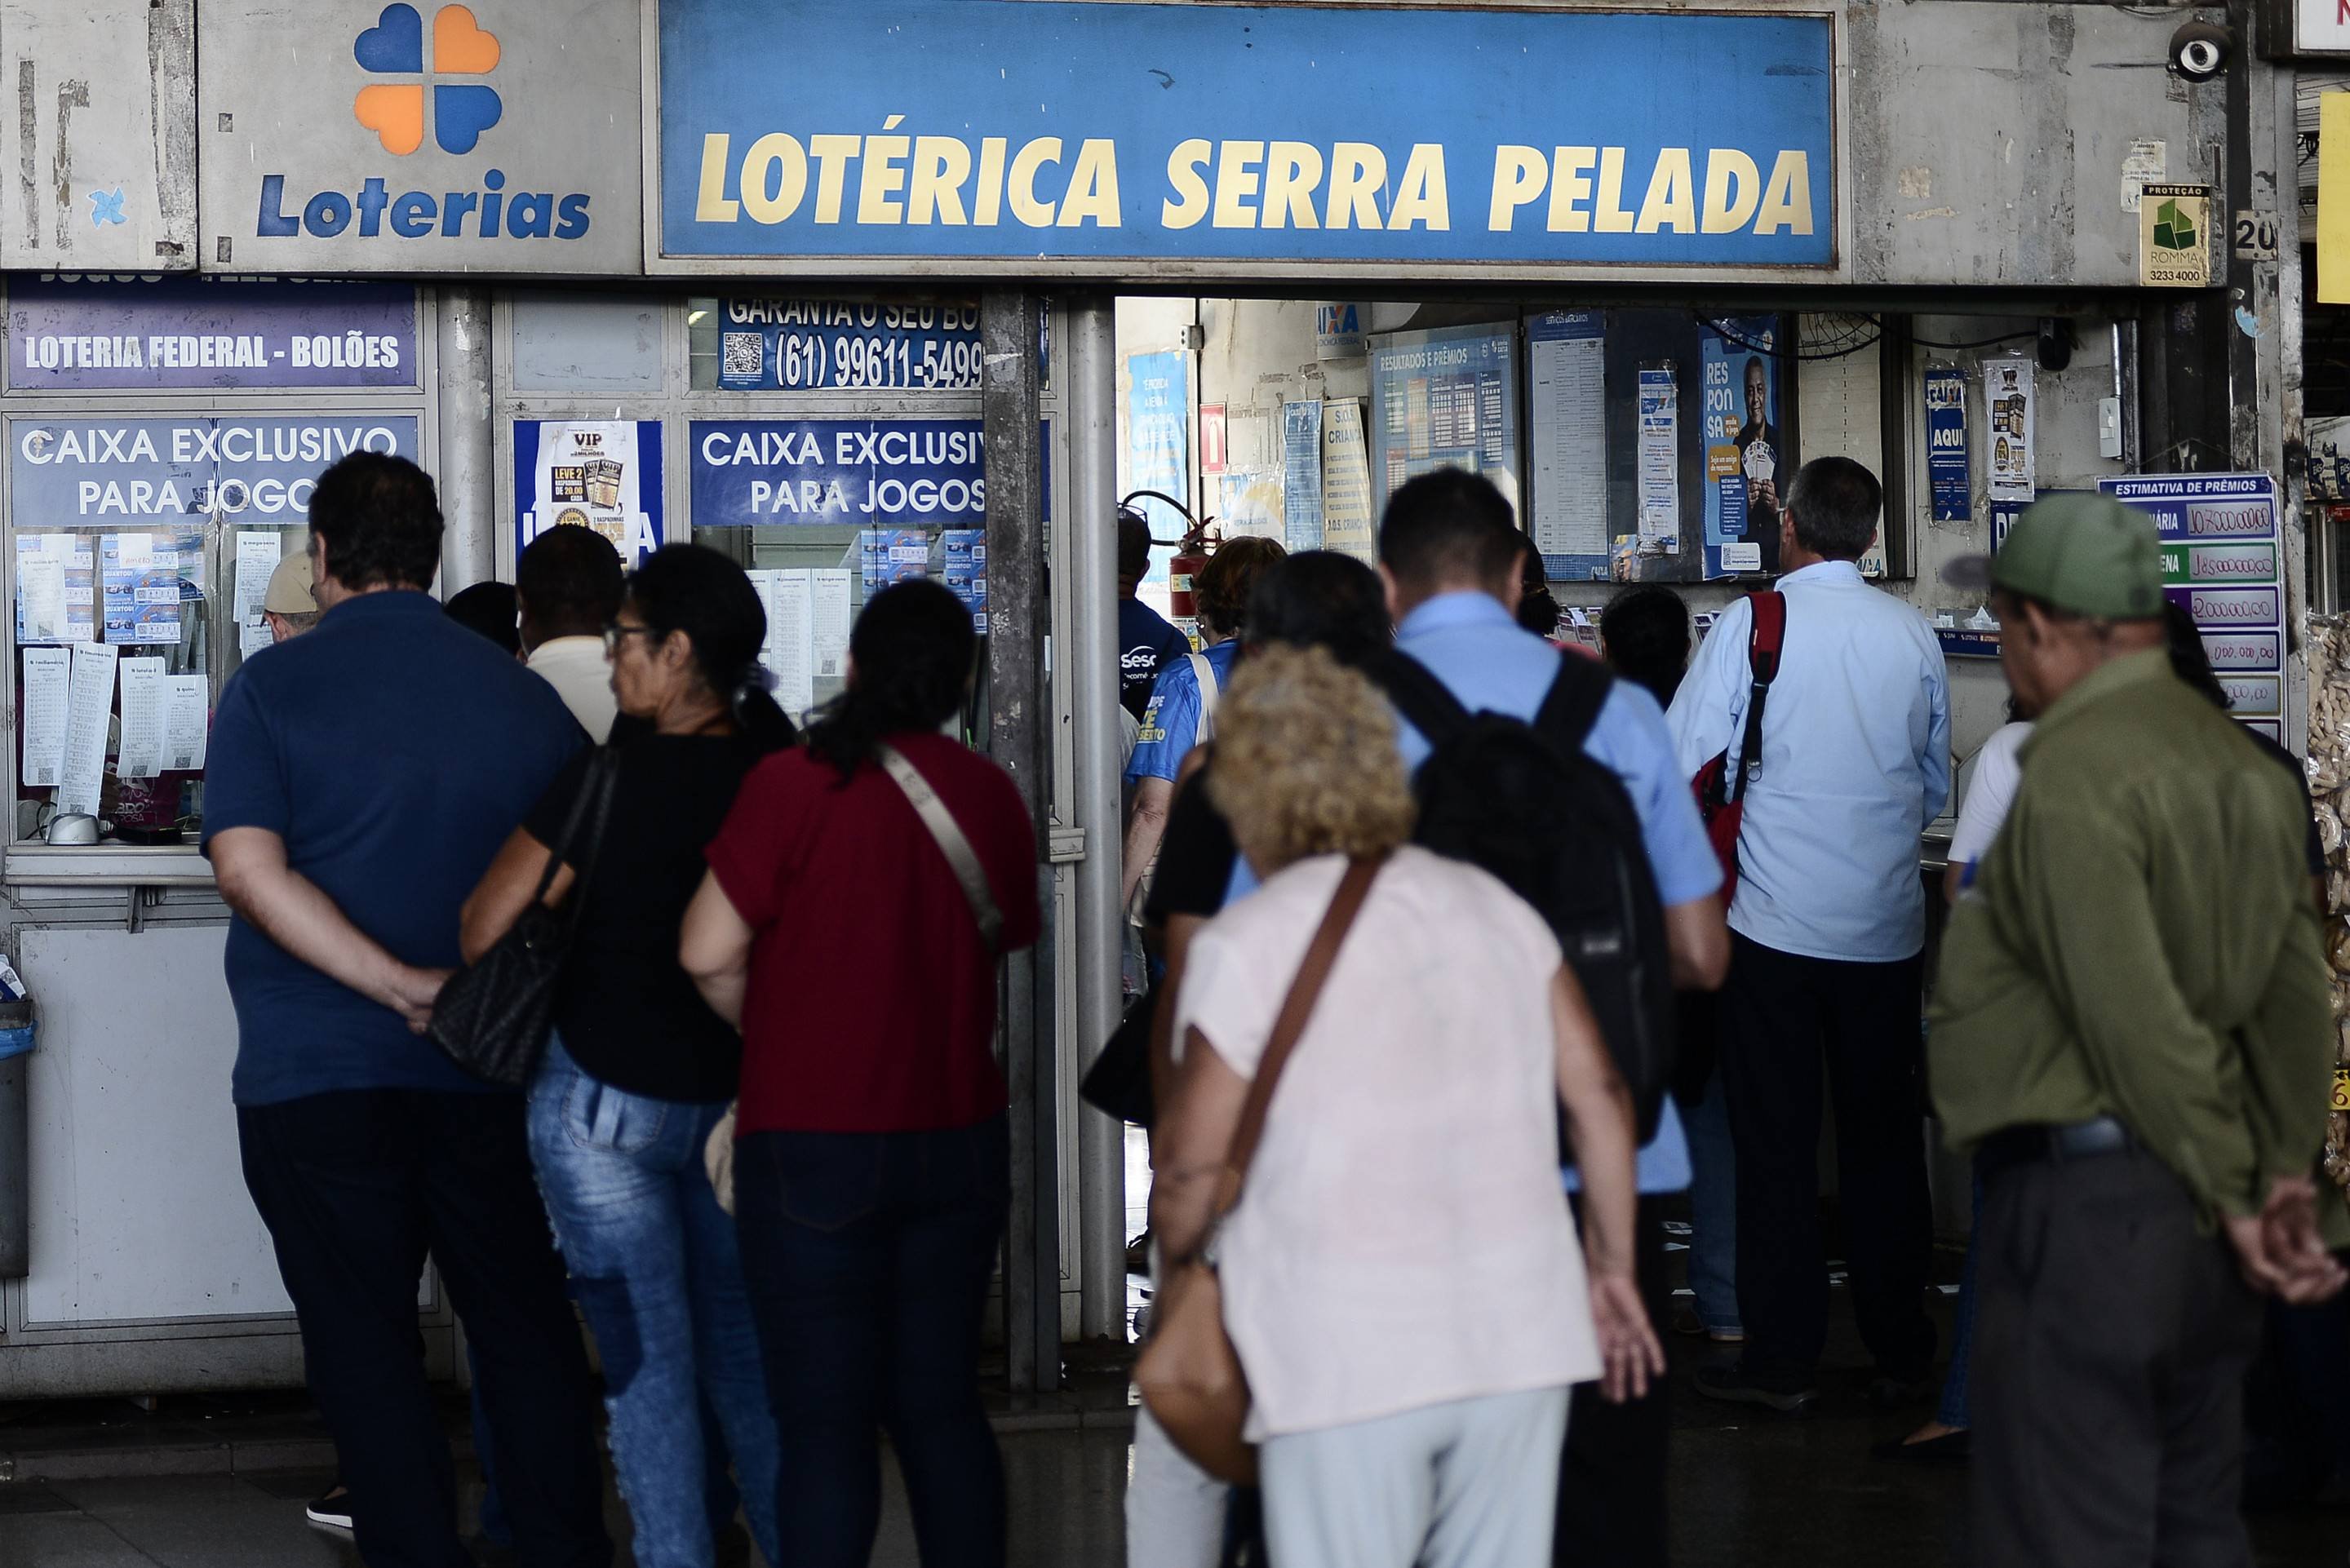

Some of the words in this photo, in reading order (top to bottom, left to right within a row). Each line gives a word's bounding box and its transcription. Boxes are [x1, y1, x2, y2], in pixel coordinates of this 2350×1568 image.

[695, 114, 1122, 228] LOTÉRICA
[1161, 138, 1450, 231] SERRA
[1488, 144, 1814, 236] PELADA
[2148, 186, 2202, 196] PROTEÇÃO
[256, 169, 591, 240] Loterias
[2237, 219, 2275, 250] 20
[2151, 251, 2199, 264] ROMMA
[2150, 271, 2174, 281] 3233
[2175, 271, 2200, 281] 4000
[25, 336, 143, 368] LOTERIA
[150, 336, 268, 368] FEDERAL
[292, 330, 399, 368] BOLÕES
[1381, 352, 1426, 372] RESULTADOS
[1428, 351, 1432, 366] E
[1434, 346, 1467, 366] PRÊMIOS
[776, 334, 827, 387] (61)
[834, 335, 982, 389] 99611-5499
[1707, 361, 1728, 385] RES
[1707, 388, 1733, 411] PON
[1707, 415, 1723, 438] SA
[1933, 428, 1963, 447] AQUI
[21, 429, 158, 464] CAIXA
[172, 427, 397, 463] EXCLUSIVO
[574, 433, 602, 446] VIP
[703, 432, 824, 466] CAIXA
[836, 431, 984, 465] EXCLUSI
[555, 468, 574, 480] LEVE
[576, 468, 583, 480] 2
[80, 481, 184, 514] PARA
[197, 479, 315, 515] JOGO
[556, 486, 564, 495] DE
[752, 480, 849, 513] PARA
[859, 479, 986, 513] JOGOS
[2116, 482, 2184, 495] ESTIMATIVA
[2187, 481, 2201, 494] DE
[2206, 479, 2256, 492] PRÊMIOS
[2333, 1083, 2349, 1106] 6
